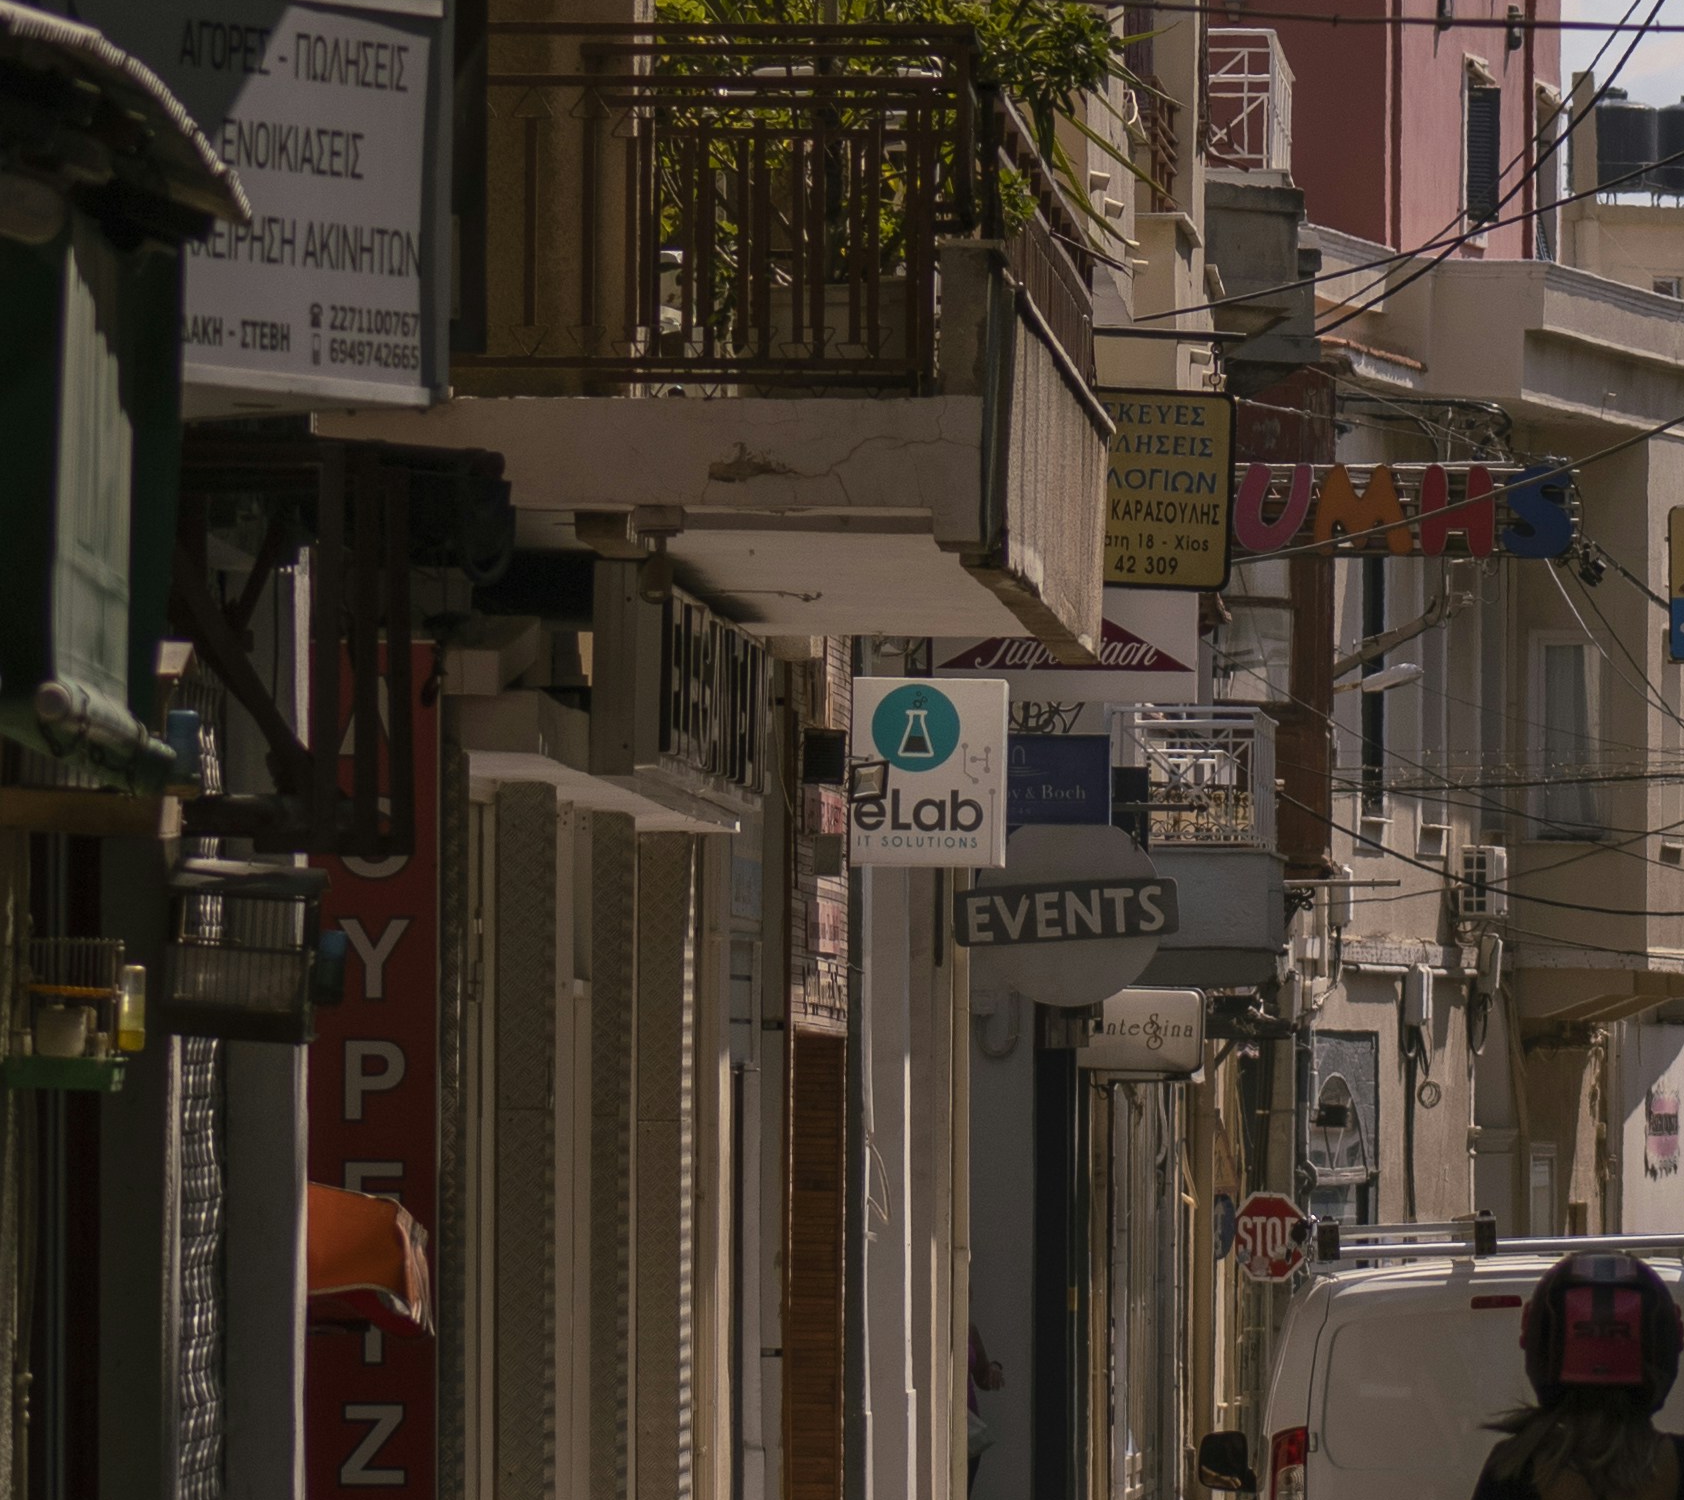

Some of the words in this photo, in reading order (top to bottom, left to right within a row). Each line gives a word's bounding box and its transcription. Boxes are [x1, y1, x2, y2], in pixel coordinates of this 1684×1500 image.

[181, 19, 271, 76] ΑΓΟΡΕΣ
[296, 33, 408, 92] ΠΩΛΗΣΕΙΣ
[221, 117, 364, 180] ΕΝΟΙΚΙΑΣΕΙΣ
[241, 319, 291, 353] ΣΤΕΒΗ
[329, 304, 419, 338] 2271100767
[329, 337, 419, 371] 6949742665
[1111, 499, 1220, 526] ΚΑΡΑΣΟΥΛΗΣ
[1139, 533, 1155, 549] 18
[1114, 555, 1137, 574] 42
[1144, 556, 1179, 576] 309
[1041, 784, 1086, 800] Boch
[853, 788, 984, 832] eLab
[857, 834, 870, 847] IT
[881, 836, 978, 848] SOLUTIONS
[966, 885, 1166, 943] EVENTS
